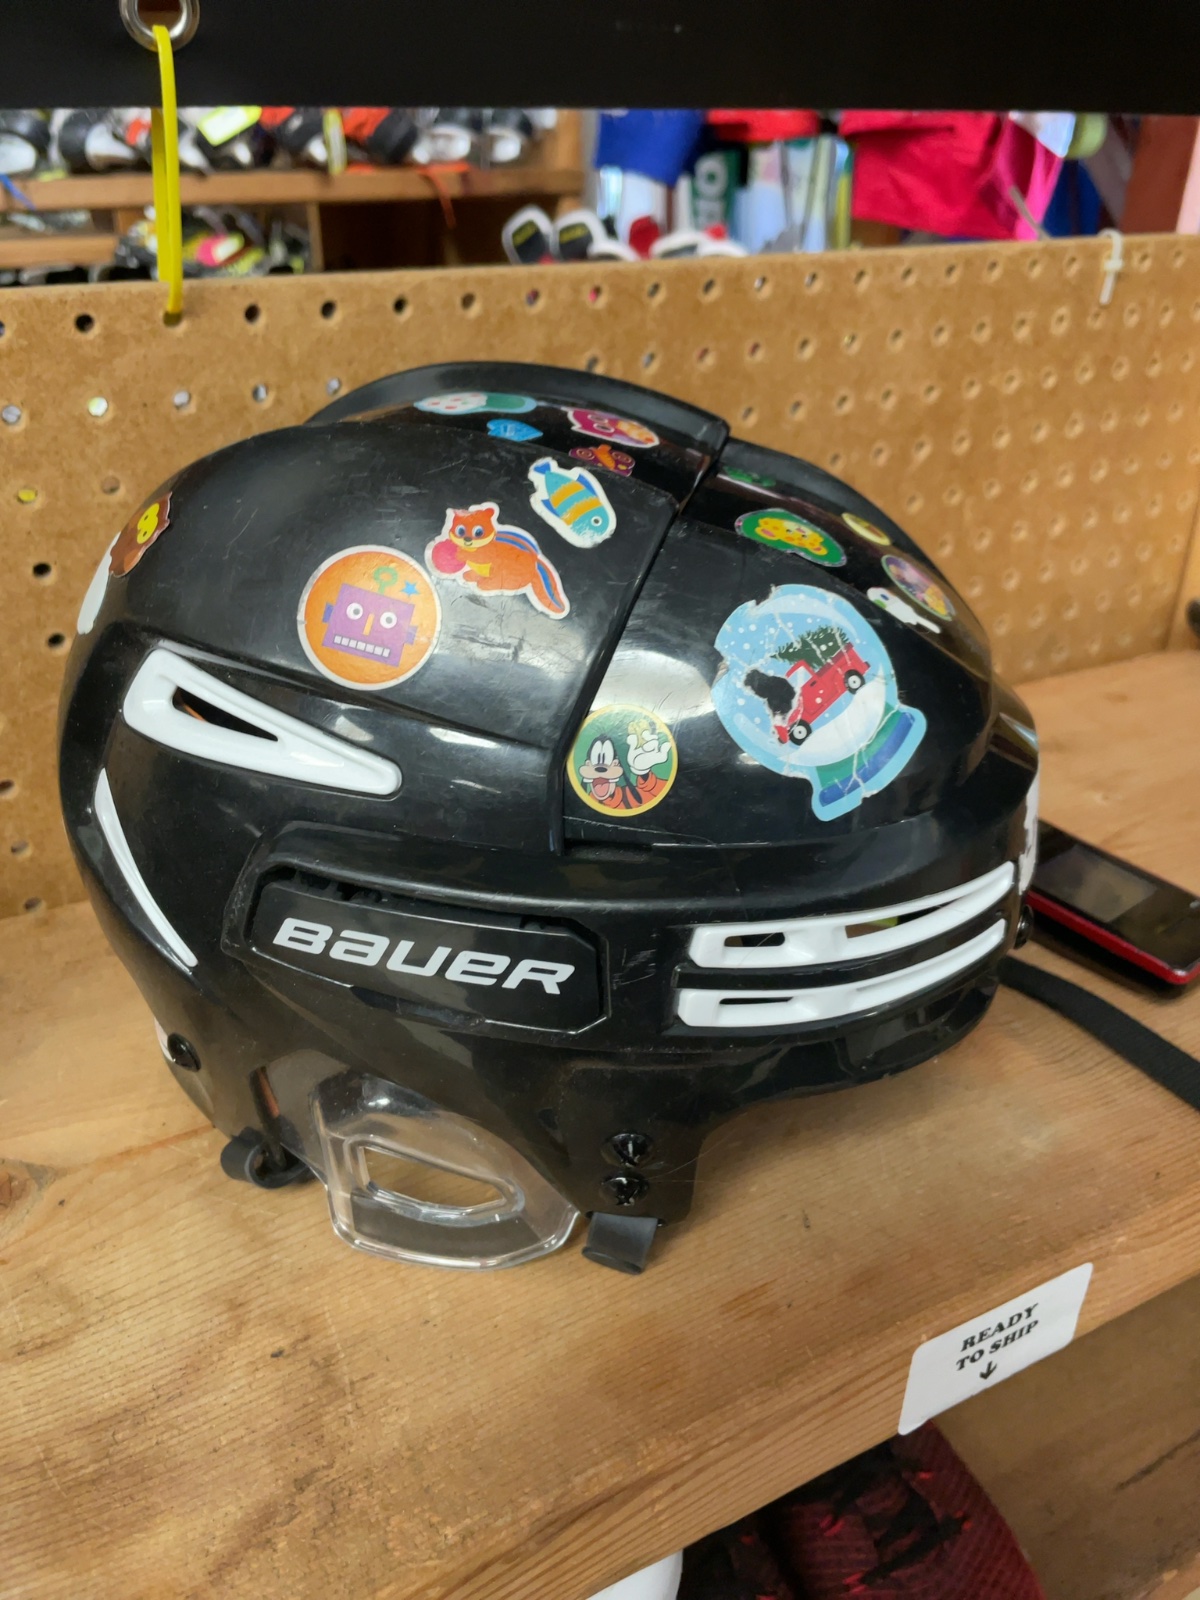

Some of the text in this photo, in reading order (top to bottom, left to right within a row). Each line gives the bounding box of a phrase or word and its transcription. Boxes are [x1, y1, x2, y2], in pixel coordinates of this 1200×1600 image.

[956, 1320, 1039, 1371] TO SHIP
[960, 1302, 1039, 1352] READY
